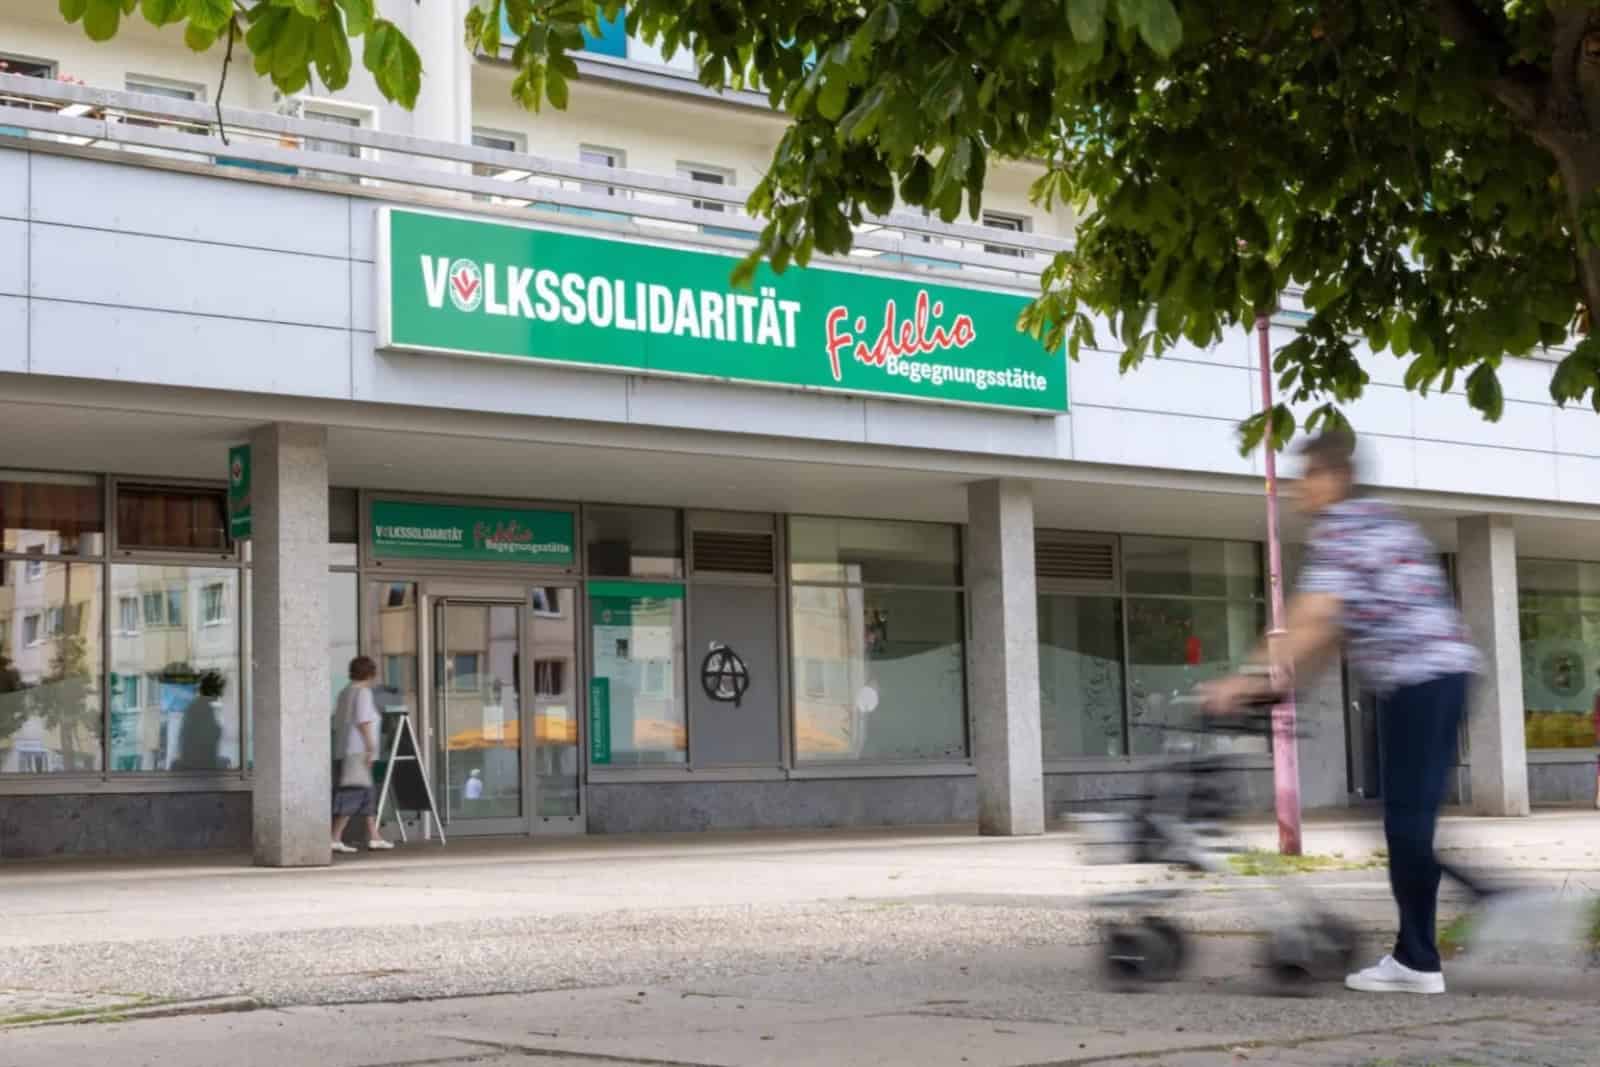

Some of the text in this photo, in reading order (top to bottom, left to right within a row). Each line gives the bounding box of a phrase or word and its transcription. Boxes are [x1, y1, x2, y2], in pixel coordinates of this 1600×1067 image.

[420, 253, 801, 349] VOLKSSOLIDARITÄT
[826, 289, 976, 382] Fidelio
[886, 354, 1048, 391] Begegnungsstätte
